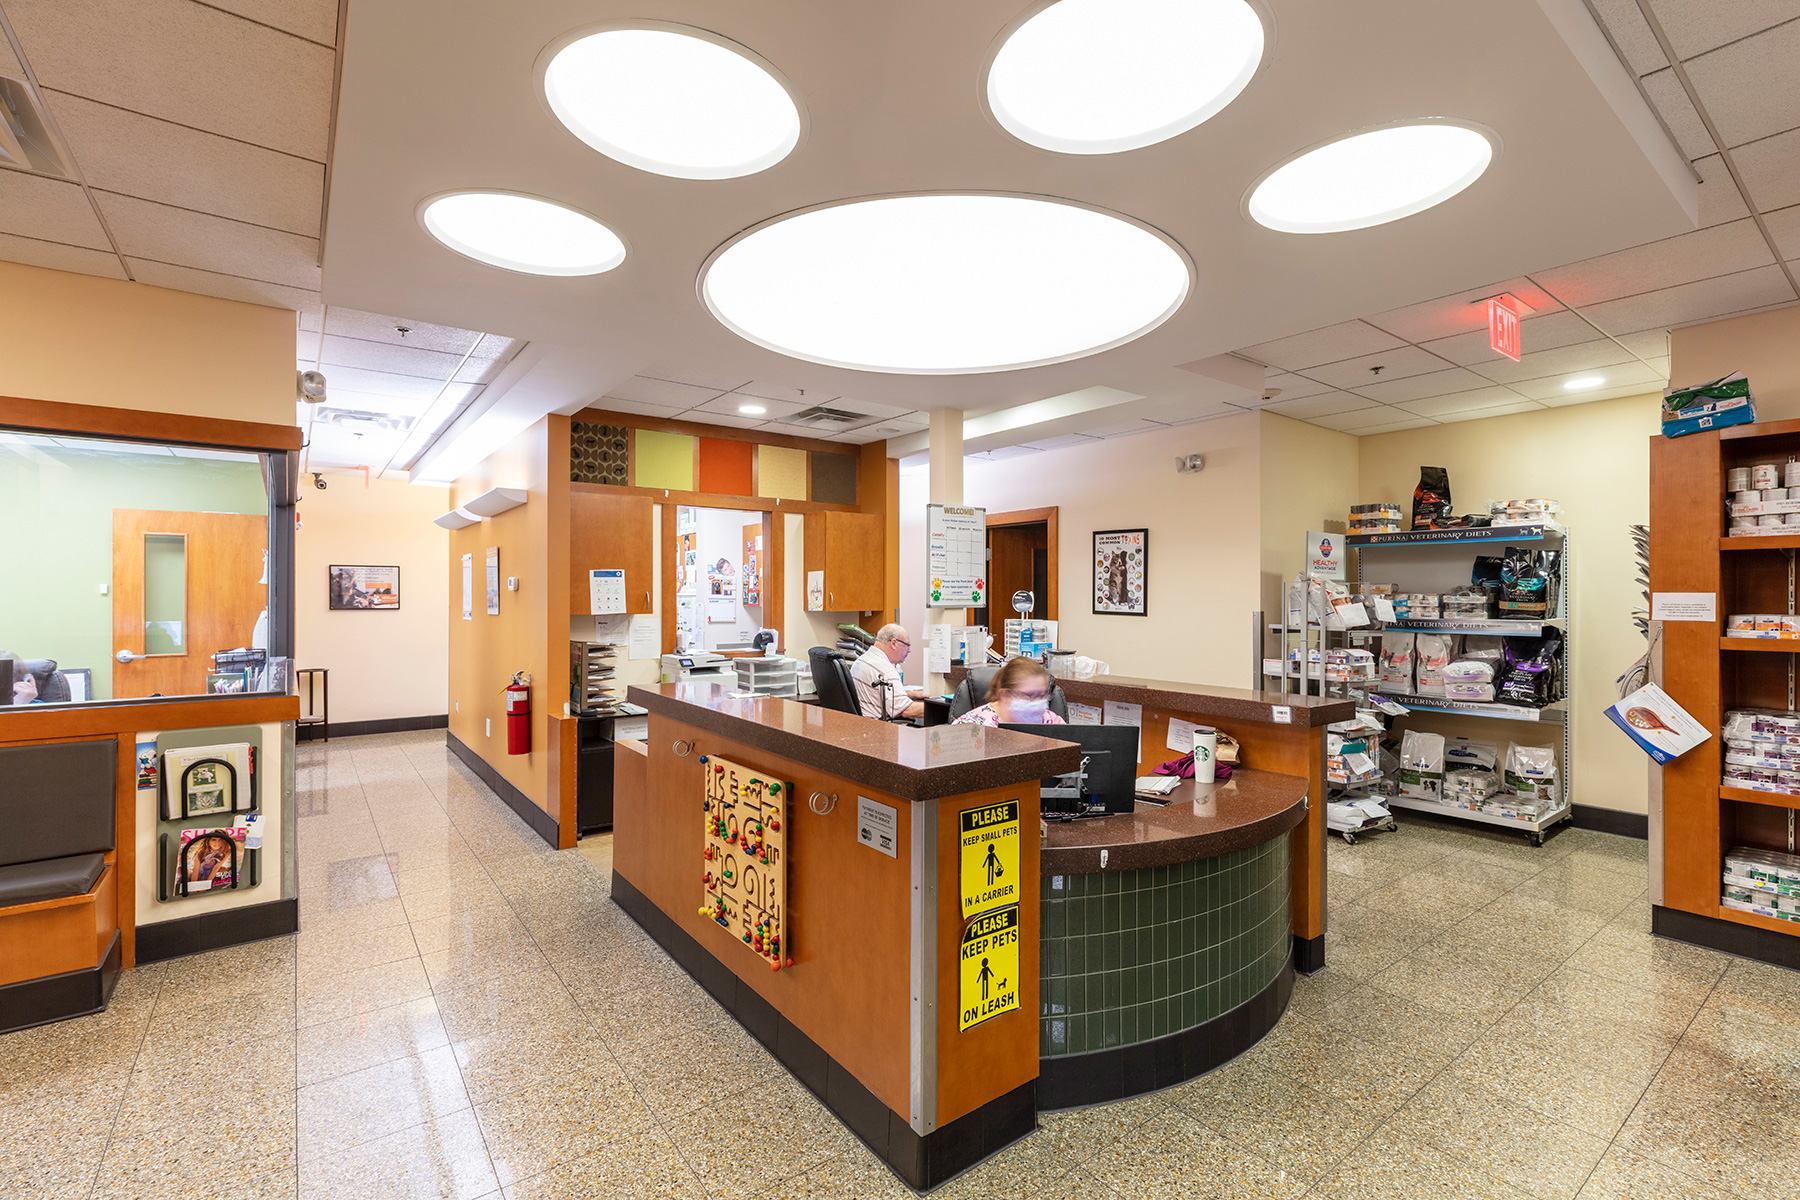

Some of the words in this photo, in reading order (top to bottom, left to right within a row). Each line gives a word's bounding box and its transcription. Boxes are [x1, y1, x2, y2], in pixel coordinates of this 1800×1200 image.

[1496, 305, 1517, 355] EXIT
[943, 506, 975, 516] WELCOME!
[1410, 532, 1463, 540] VETERINARY
[1407, 621, 1460, 630] VETERINARY
[1398, 697, 1451, 708] VETERINARY
[1453, 701, 1479, 709] DIETS
[971, 806, 1009, 827] PLEASE
[180, 827, 247, 844] SHPE
[963, 835, 979, 847] KEEP
[981, 831, 1001, 843] SMALL
[1002, 826, 1018, 837] PETS
[965, 898, 973, 907] IN
[975, 894, 980, 904] A
[982, 885, 1014, 902] CARRIER
[971, 913, 1009, 938] PLEASE
[962, 939, 988, 960] KEEP
[992, 929, 1017, 949] PETS
[963, 1006, 978, 1023] ON
[982, 991, 1014, 1016] LEASH
